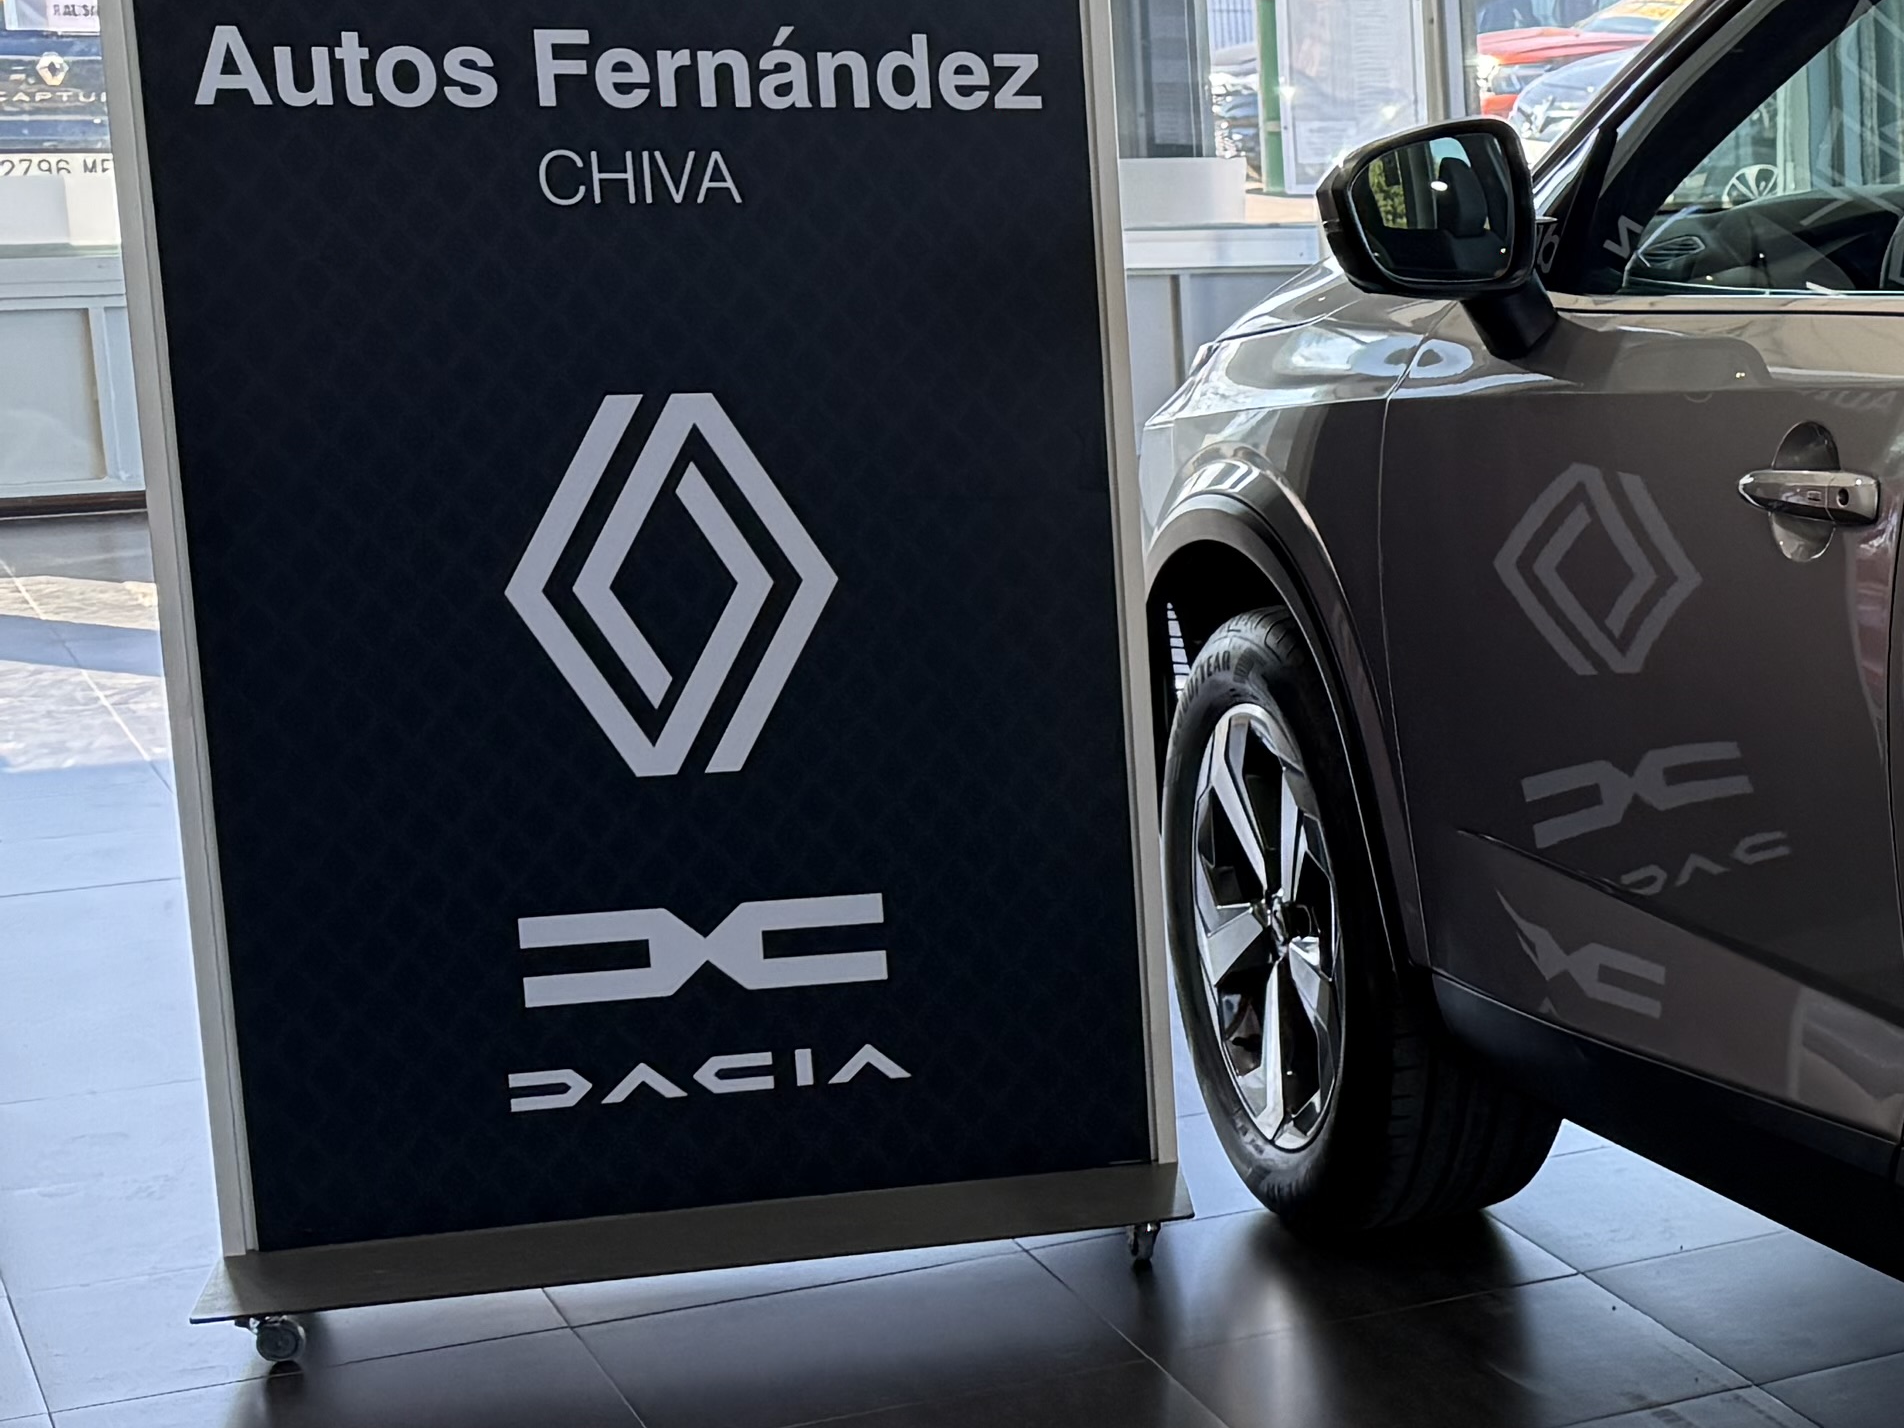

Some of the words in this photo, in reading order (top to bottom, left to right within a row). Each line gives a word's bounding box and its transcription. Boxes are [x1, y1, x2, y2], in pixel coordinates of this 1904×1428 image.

[195, 24, 499, 109] Autos
[533, 25, 1043, 111] Fernández
[538, 149, 743, 207] CHIVA
[508, 1044, 912, 1113] DACIA
